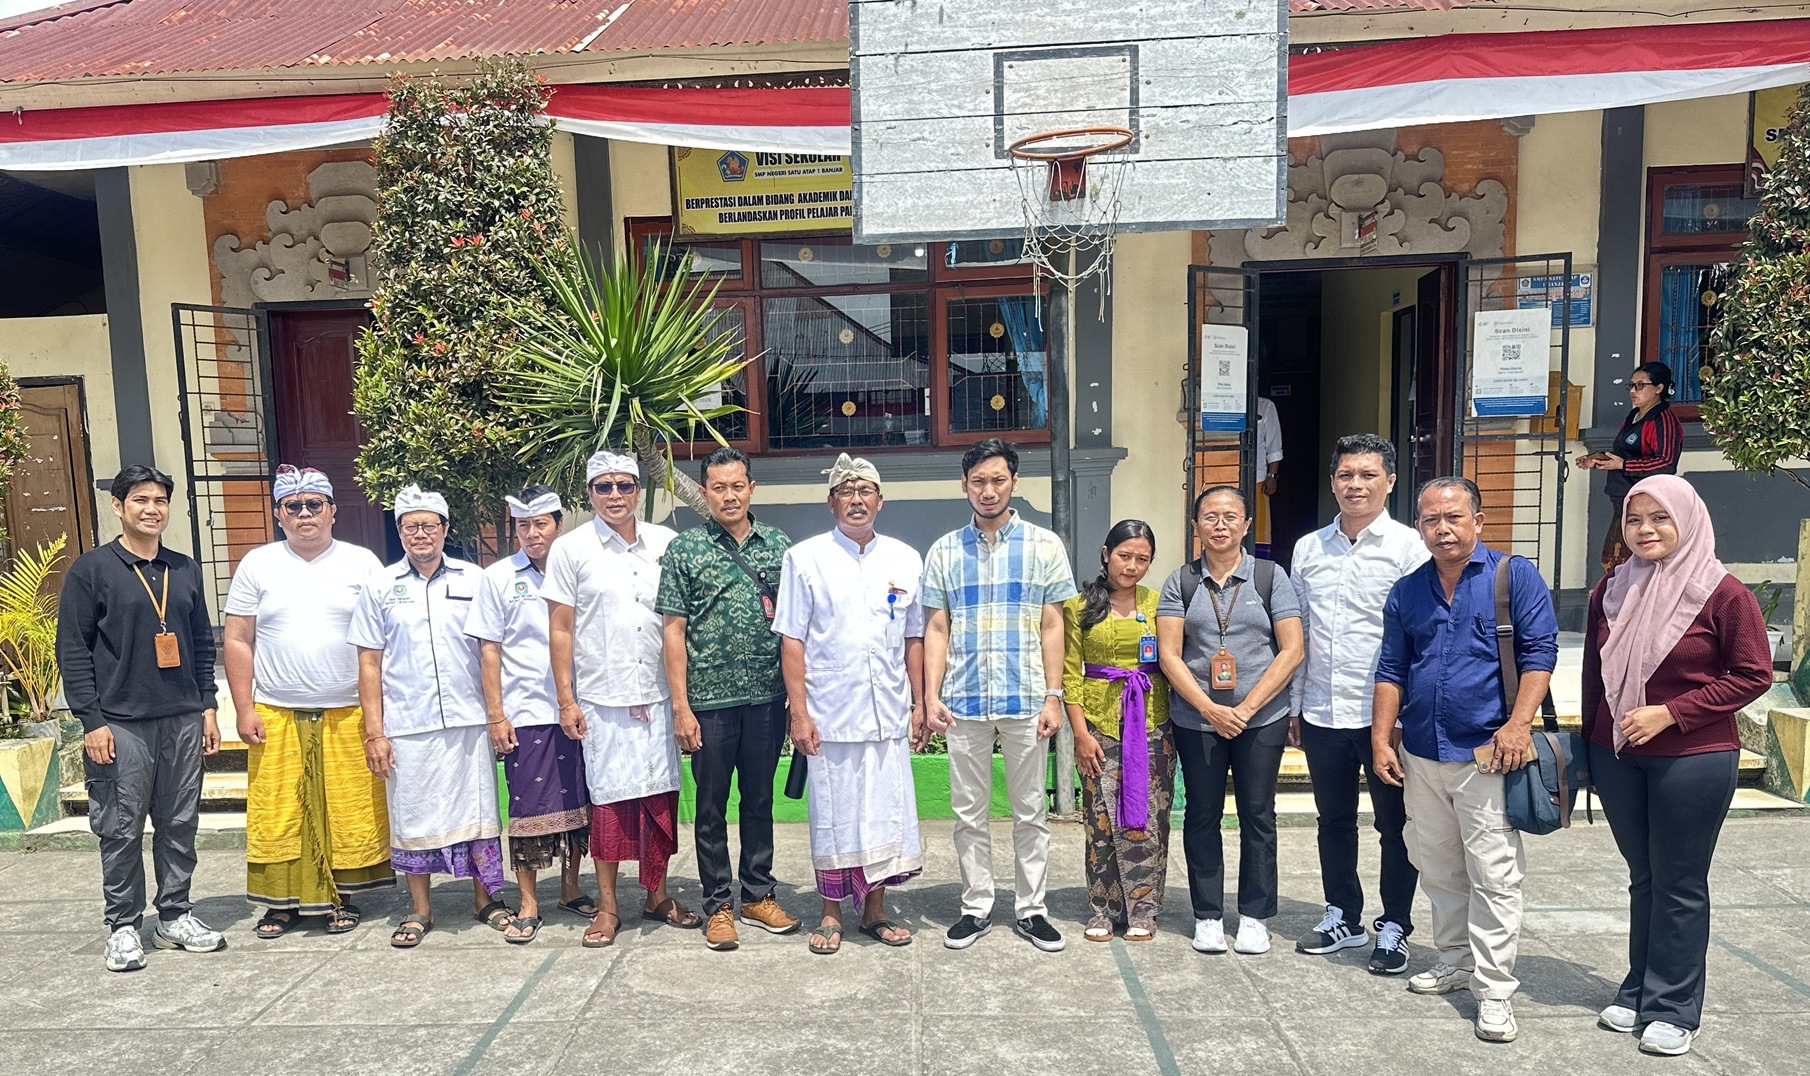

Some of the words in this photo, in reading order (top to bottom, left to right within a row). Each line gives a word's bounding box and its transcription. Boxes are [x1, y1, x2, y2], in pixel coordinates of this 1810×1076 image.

[755, 152, 782, 166] VISI
[685, 196, 736, 210] BERPRESTASI
[737, 195, 764, 207] DALAM
[765, 193, 795, 206] BIDANG
[797, 191, 838, 204] AKADEMIK
[718, 209, 778, 224] BERLANDASKAN
[779, 208, 806, 221] PROFIL
[807, 206, 839, 219] PELAJAR
